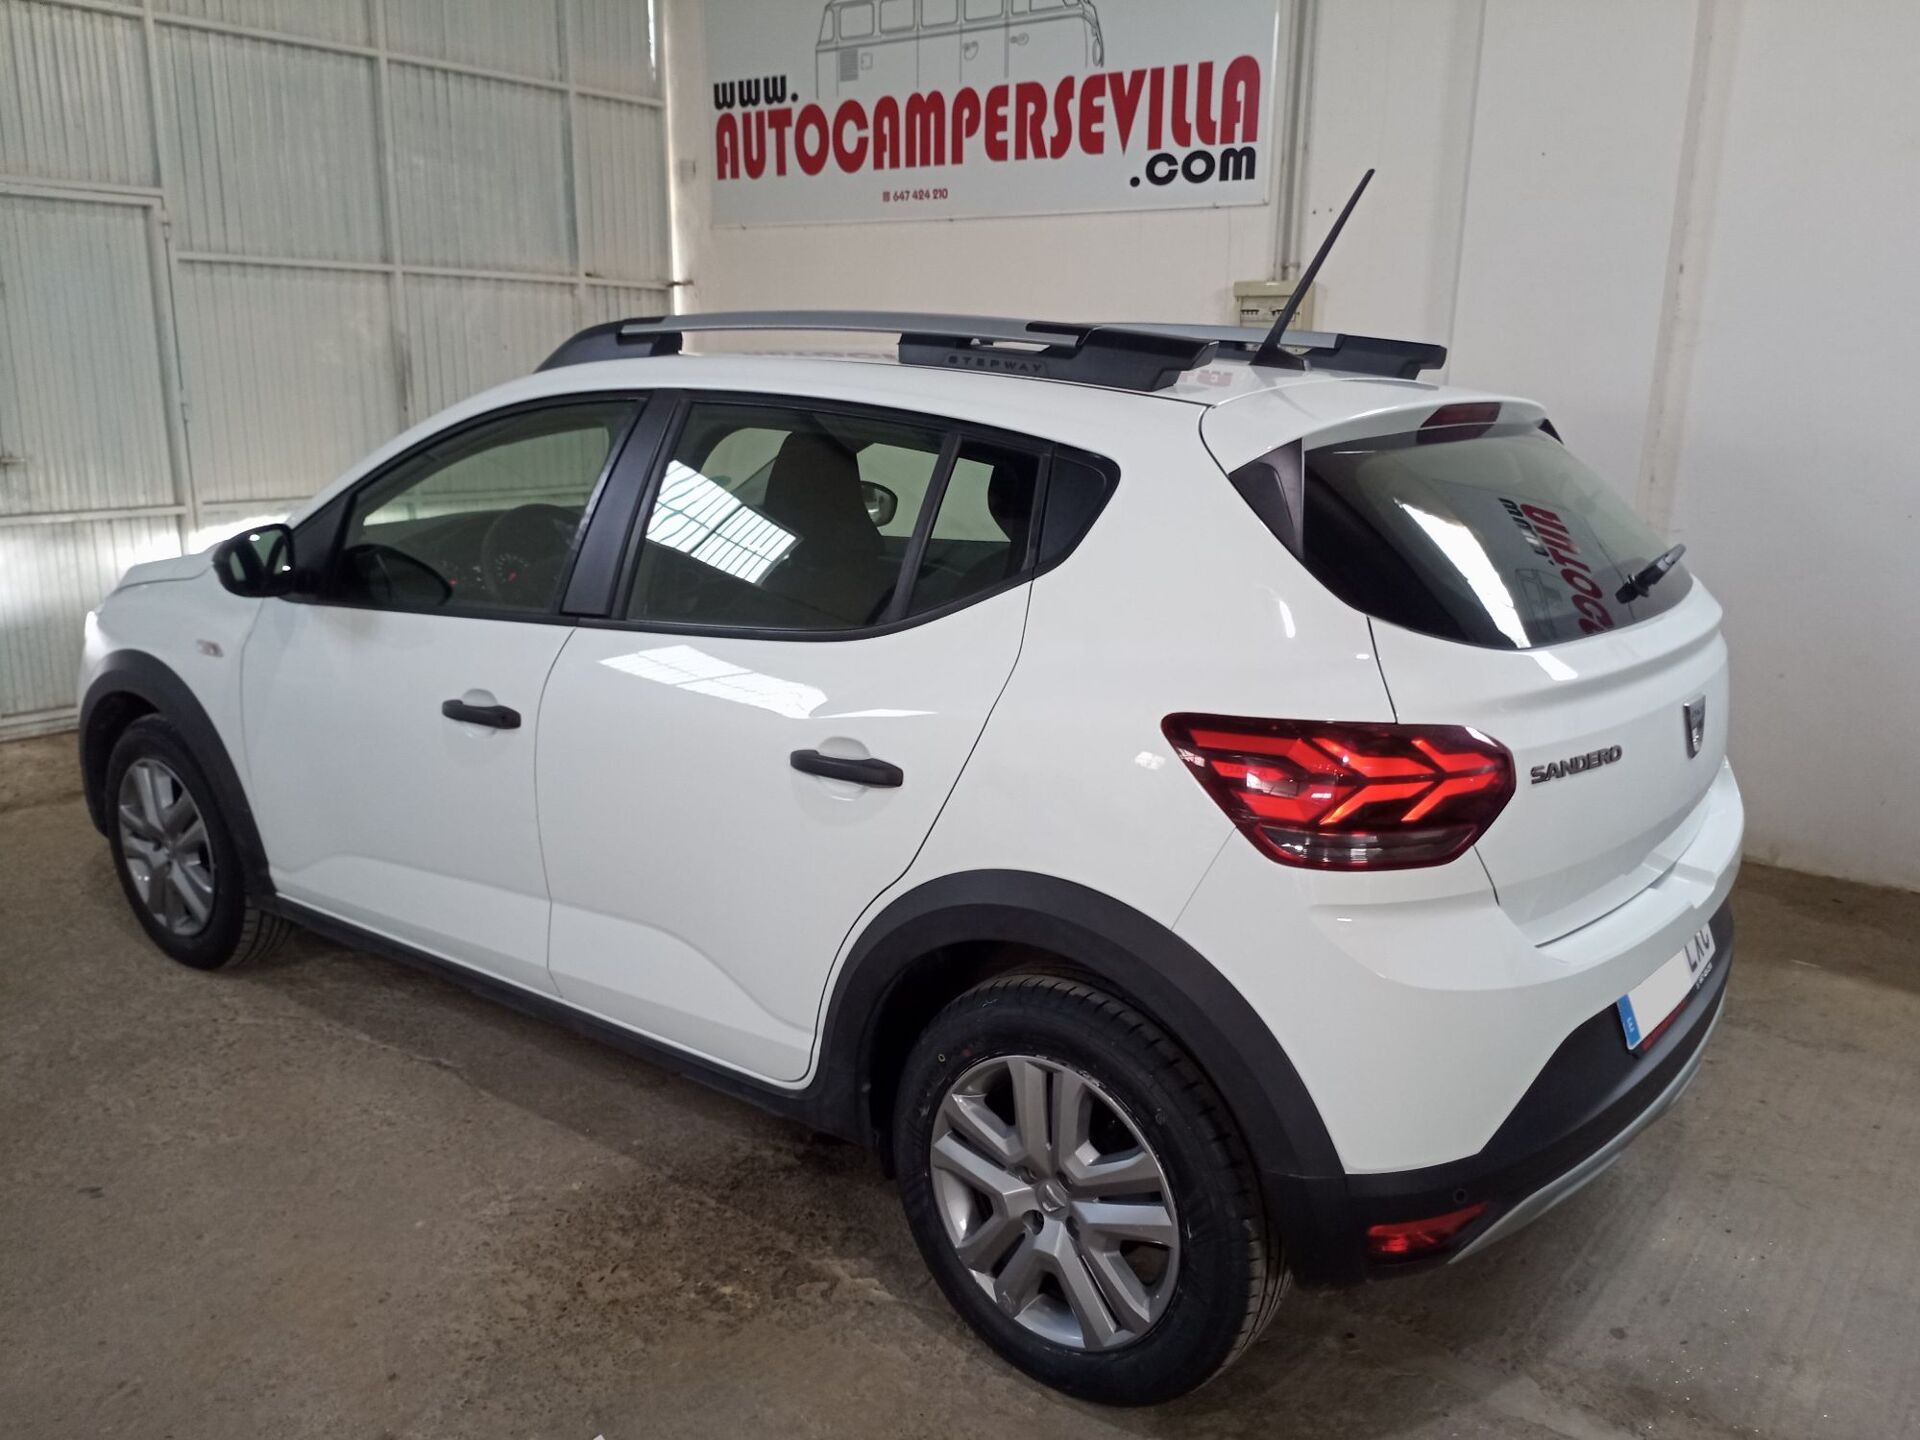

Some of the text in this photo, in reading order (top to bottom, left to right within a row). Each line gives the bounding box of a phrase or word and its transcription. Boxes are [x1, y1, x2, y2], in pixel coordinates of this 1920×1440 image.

[713, 75, 798, 110] www.
[716, 55, 1261, 180] AUTOCAMPERSEVILLA
[1129, 146, 1256, 188] .com
[893, 188, 949, 202] 647 424 210
[948, 355, 1041, 372] STEPWAY
[1530, 744, 1623, 785] SANDERO
